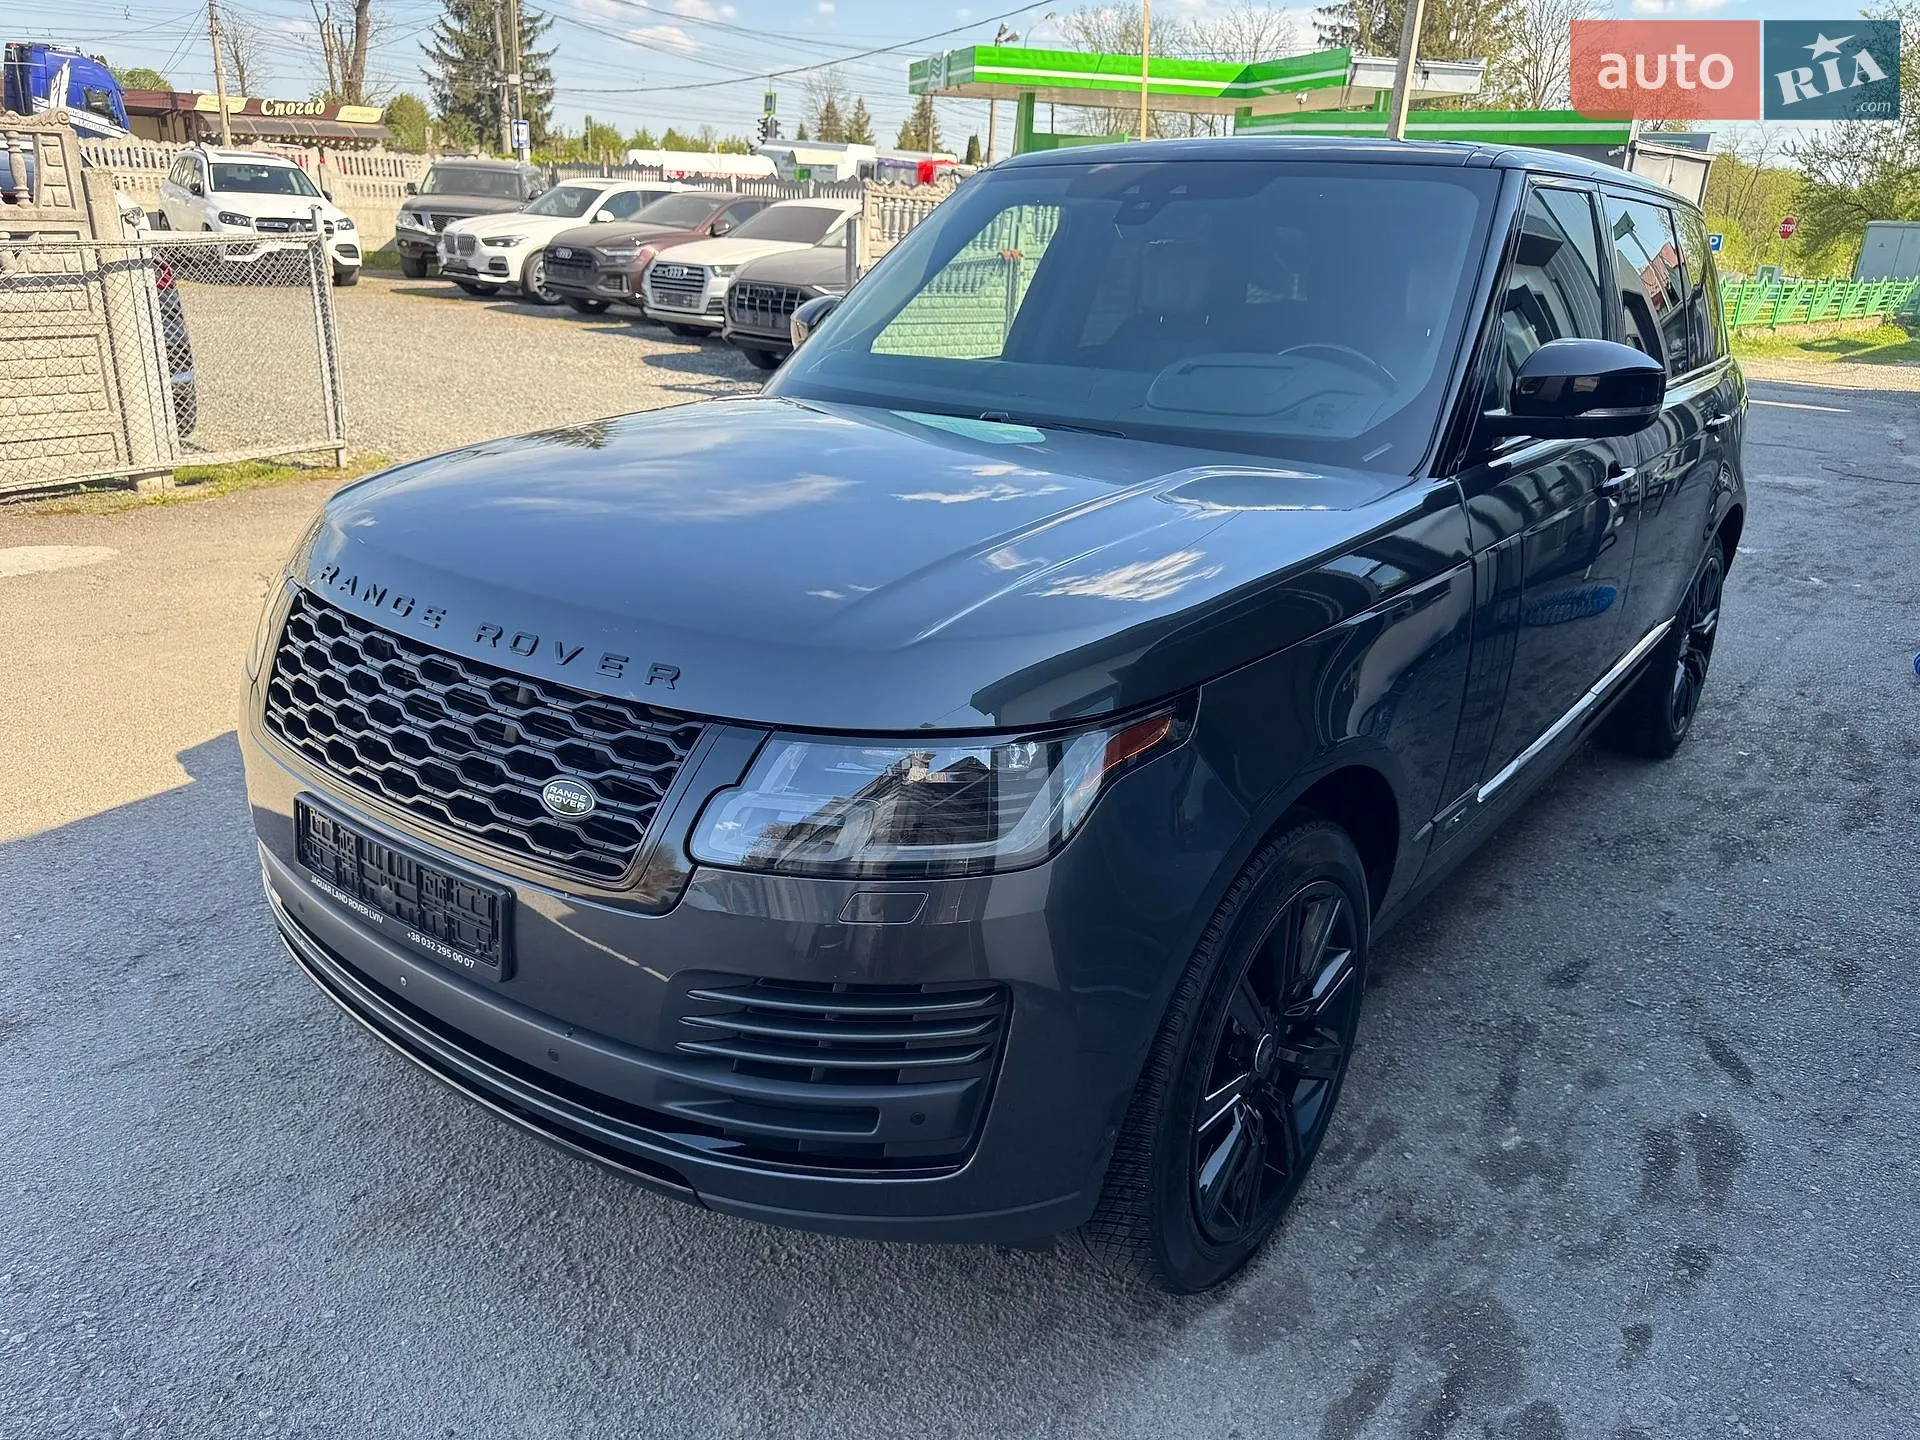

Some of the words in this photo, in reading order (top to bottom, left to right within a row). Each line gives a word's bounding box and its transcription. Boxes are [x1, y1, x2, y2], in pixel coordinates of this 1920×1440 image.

[260, 98, 326, 117] Спогад
[1780, 223, 1795, 233] STOP
[1709, 236, 1719, 249] P
[319, 562, 447, 630] RANGE
[472, 620, 682, 690] ROVER
[547, 792, 586, 810] ROVER
[549, 785, 588, 802] RANGE
[311, 875, 332, 895] JAGUAR
[332, 888, 348, 904] LAND
[348, 898, 369, 917] ROVER
[369, 909, 384, 924] LVIV
[407, 931, 420, 943] +38
[421, 937, 436, 951] 032
[437, 944, 452, 958] 295
[452, 952, 463, 964] 00
[464, 957, 475, 969] 07
